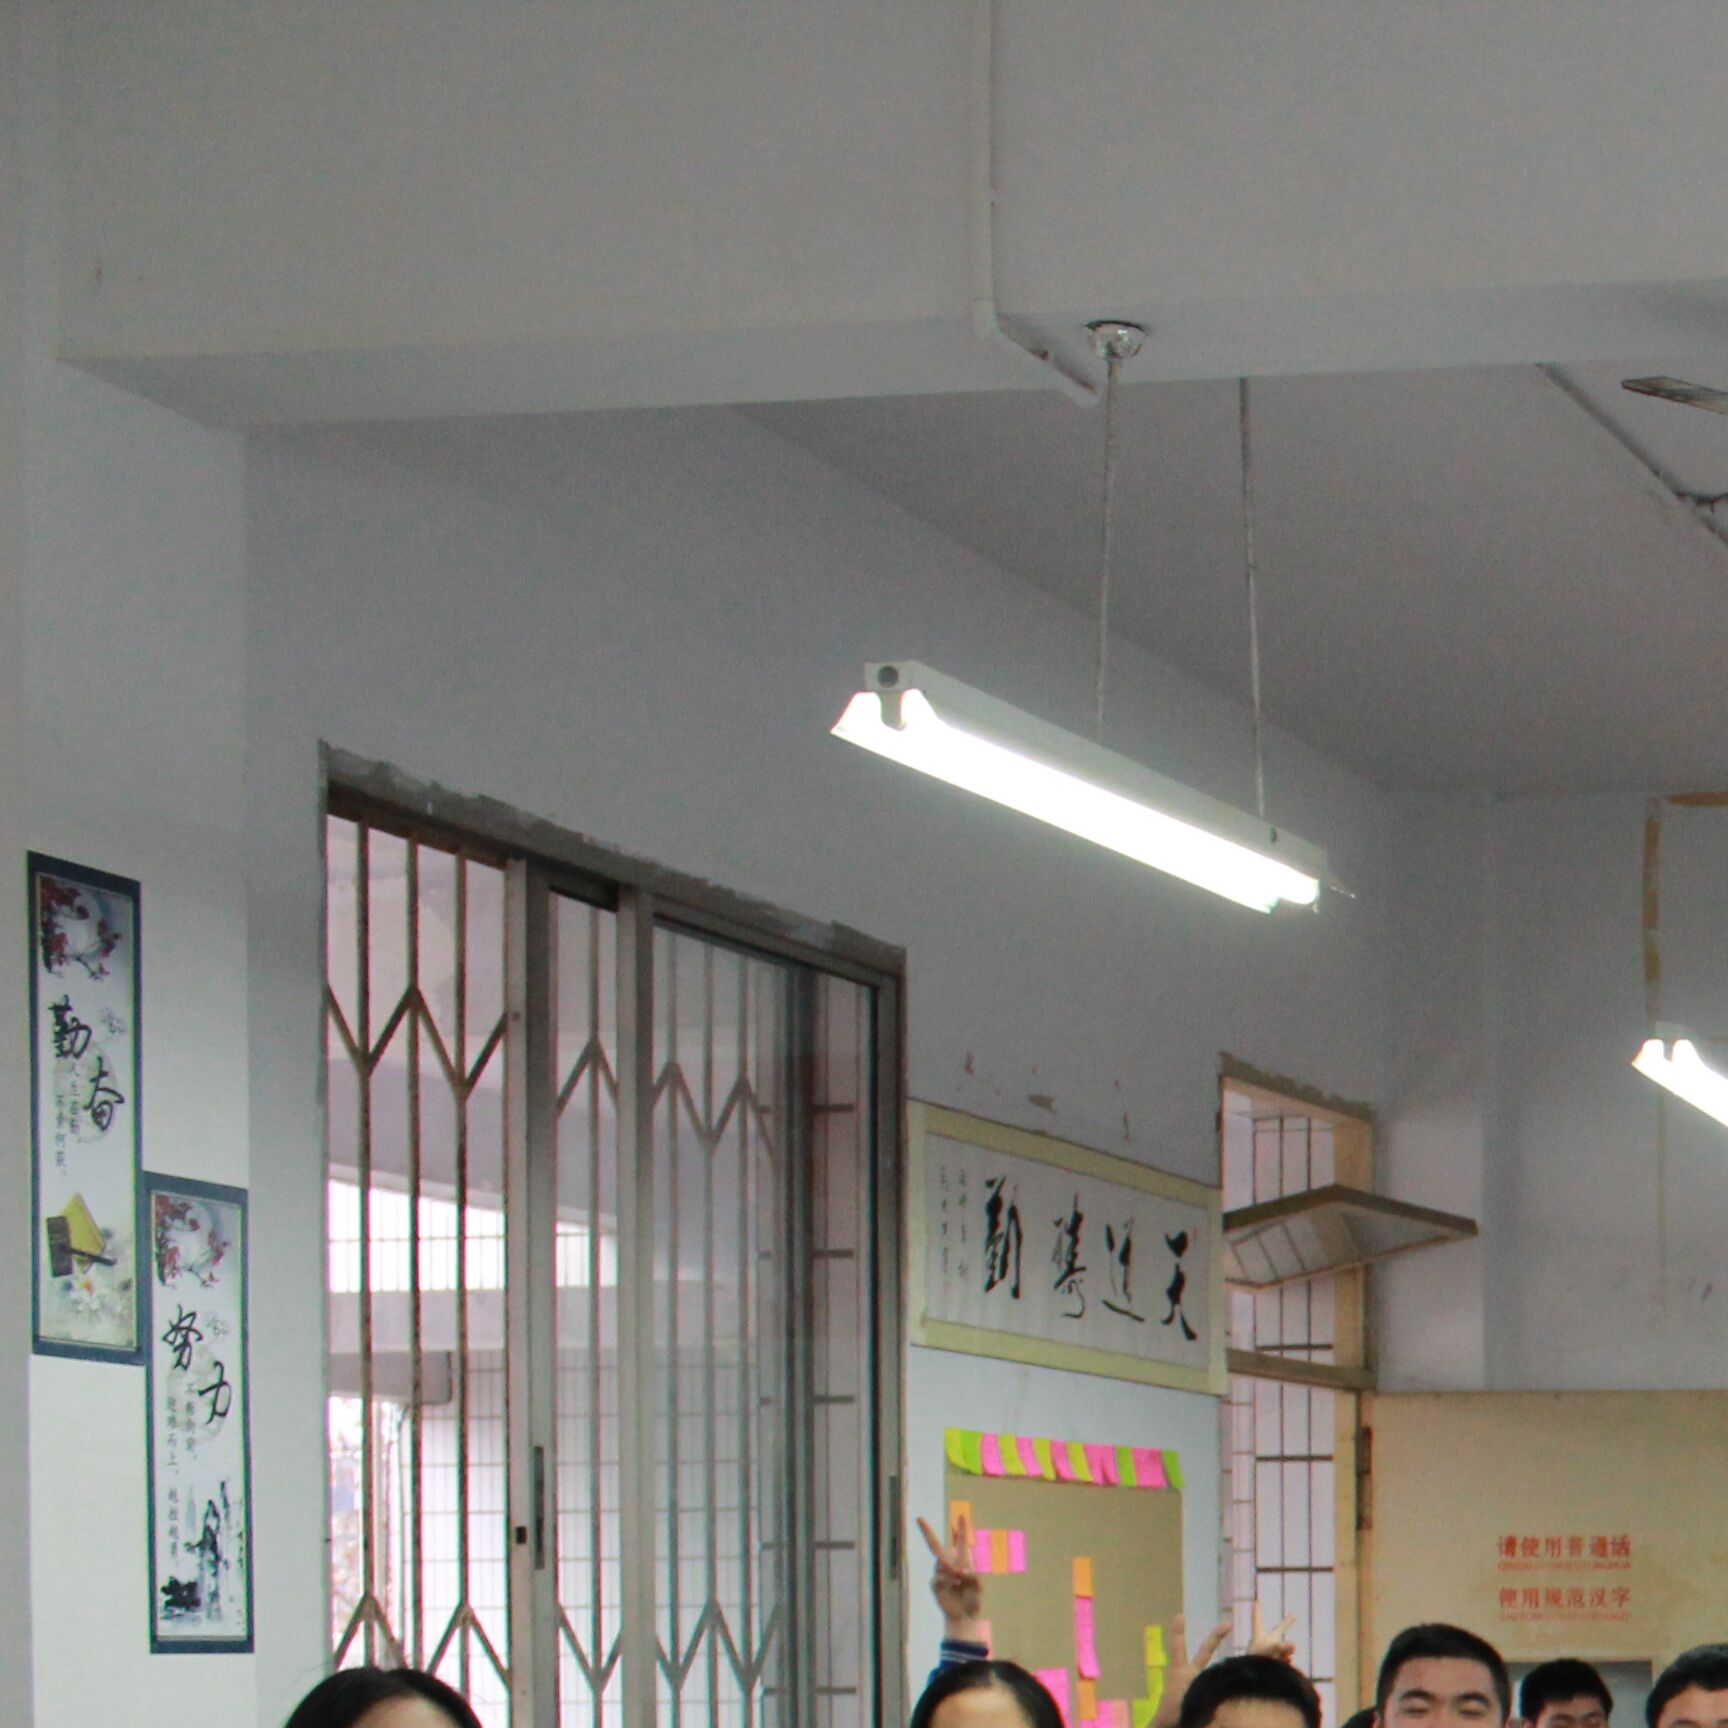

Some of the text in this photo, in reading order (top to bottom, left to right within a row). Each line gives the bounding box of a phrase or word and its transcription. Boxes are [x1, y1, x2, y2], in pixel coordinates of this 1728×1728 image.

[161, 1303, 233, 1425] 努力
[1497, 1534, 1632, 1558] 请使用普通话
[1498, 1587, 1631, 1609] 使用规范汉字
